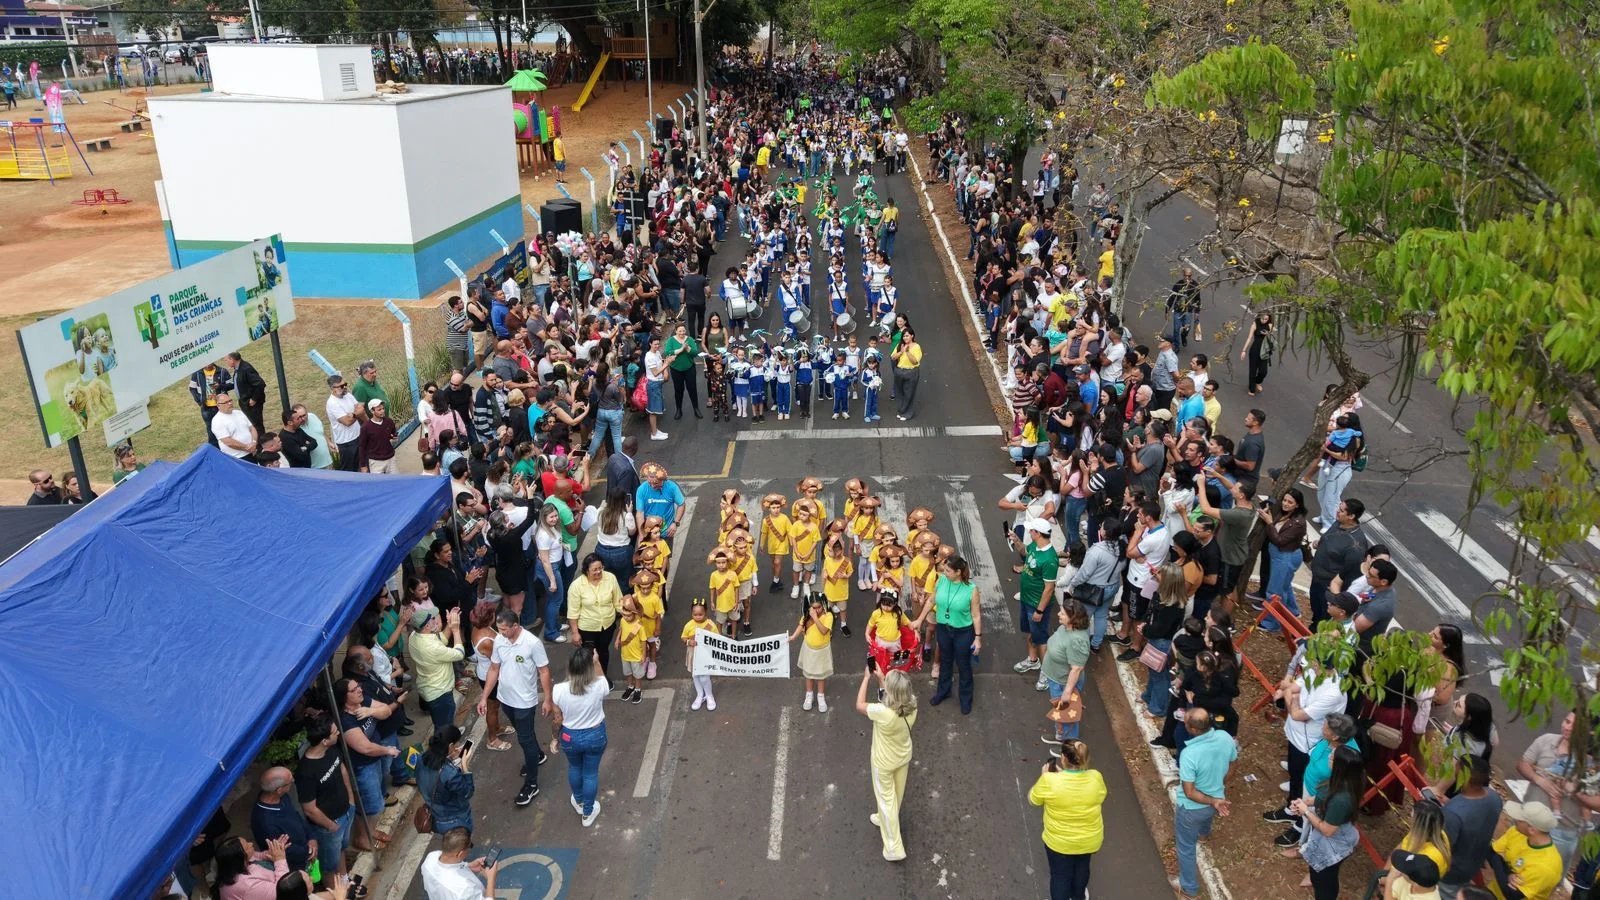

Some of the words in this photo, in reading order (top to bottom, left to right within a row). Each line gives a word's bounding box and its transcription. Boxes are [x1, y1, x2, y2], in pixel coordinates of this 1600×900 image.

[169, 285, 198, 304] PARQUE
[171, 292, 209, 315] MUNICIPAL
[173, 312, 188, 326] DAS
[189, 297, 222, 319] CRIANÇAS
[176, 326, 184, 335] DE
[185, 319, 201, 330] NOVA
[160, 352, 174, 364] AQUI
[173, 348, 180, 357] SE
[180, 342, 194, 353] CRIA
[199, 330, 220, 345] ALEGRIA
[170, 360, 178, 369] DE
[178, 355, 189, 365] SER
[188, 342, 214, 361] CRIANÇA!
[704, 635, 728, 651] EMEB
[730, 640, 780, 654] GRAZIOSO
[711, 649, 771, 665] MARCHIORO
[719, 665, 746, 673] RENATO
